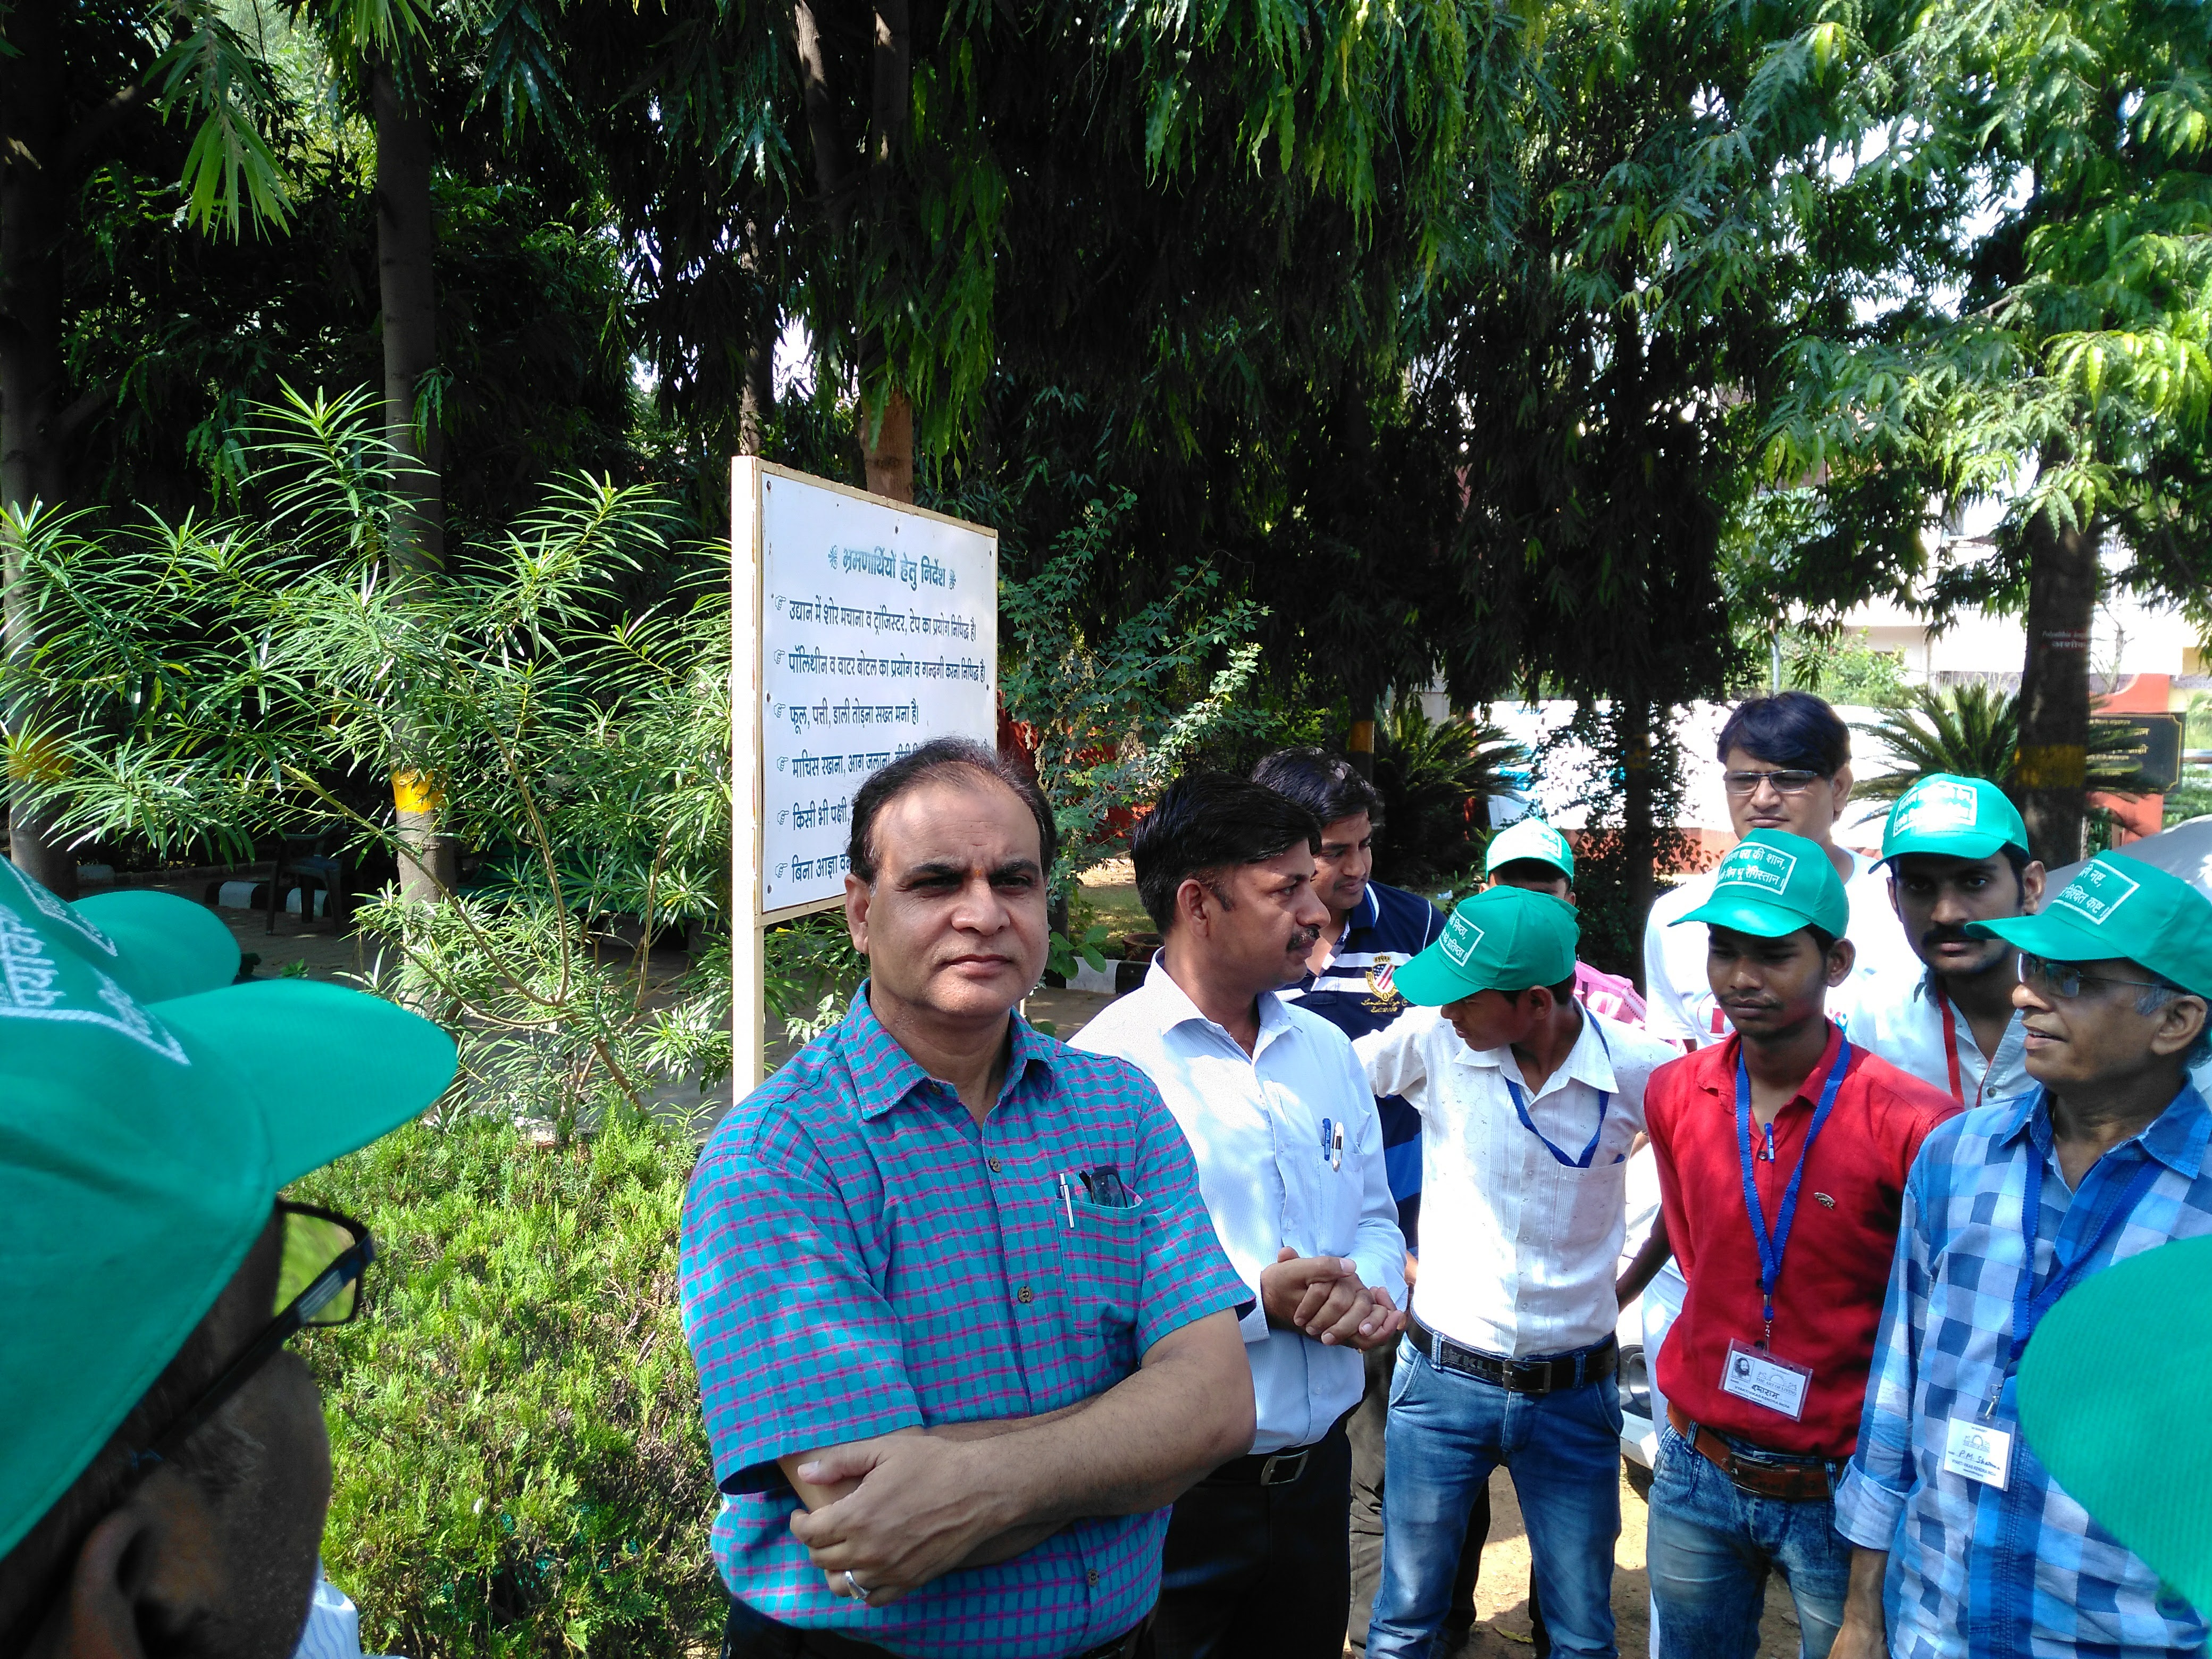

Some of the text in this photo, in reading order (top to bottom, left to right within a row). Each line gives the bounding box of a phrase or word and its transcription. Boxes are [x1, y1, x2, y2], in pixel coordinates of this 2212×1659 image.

[900, 552, 917, 591] हेतु
[921, 556, 945, 586] निर्देश
[790, 600, 813, 622] उद्यान
[824, 597, 839, 625] शोर
[841, 607, 864, 627] मचाना
[866, 611, 872, 629] व
[874, 605, 907, 635] ट्रांजिस्टर,
[910, 608, 920, 633] टेप
[923, 617, 931, 634] का
[933, 612, 950, 636] प्रयोग
[951, 614, 969, 641] निषिद्ध
[789, 645, 827, 674] पॉलिथीन
[830, 656, 835, 674] व
[837, 657, 855, 675] वाटर
[857, 650, 877, 676] बोटल
[879, 659, 889, 676] का
[891, 652, 912, 677] प्रयोग
[915, 661, 920, 678] व
[922, 656, 944, 680] गन्दगी
[946, 664, 960, 680] करना
[961, 657, 978, 682] निषिद्ध
[790, 706, 810, 734] फूल,
[812, 697, 831, 728] पत्ती,
[833, 698, 850, 724] डाली
[852, 698, 874, 728] तोड़ना
[876, 706, 893, 723] सख्त
[895, 706, 910, 722] मना
[792, 749, 819, 778] माचिस
[822, 756, 845, 777] रखना,
[848, 754, 864, 772] आग
[793, 796, 850, 830] किसी भी पक्षी,
[792, 854, 814, 883] बिना
[816, 855, 837, 879] आज्ञा
[1753, 848, 1765, 861] की
[1766, 853, 1785, 870] शान,
